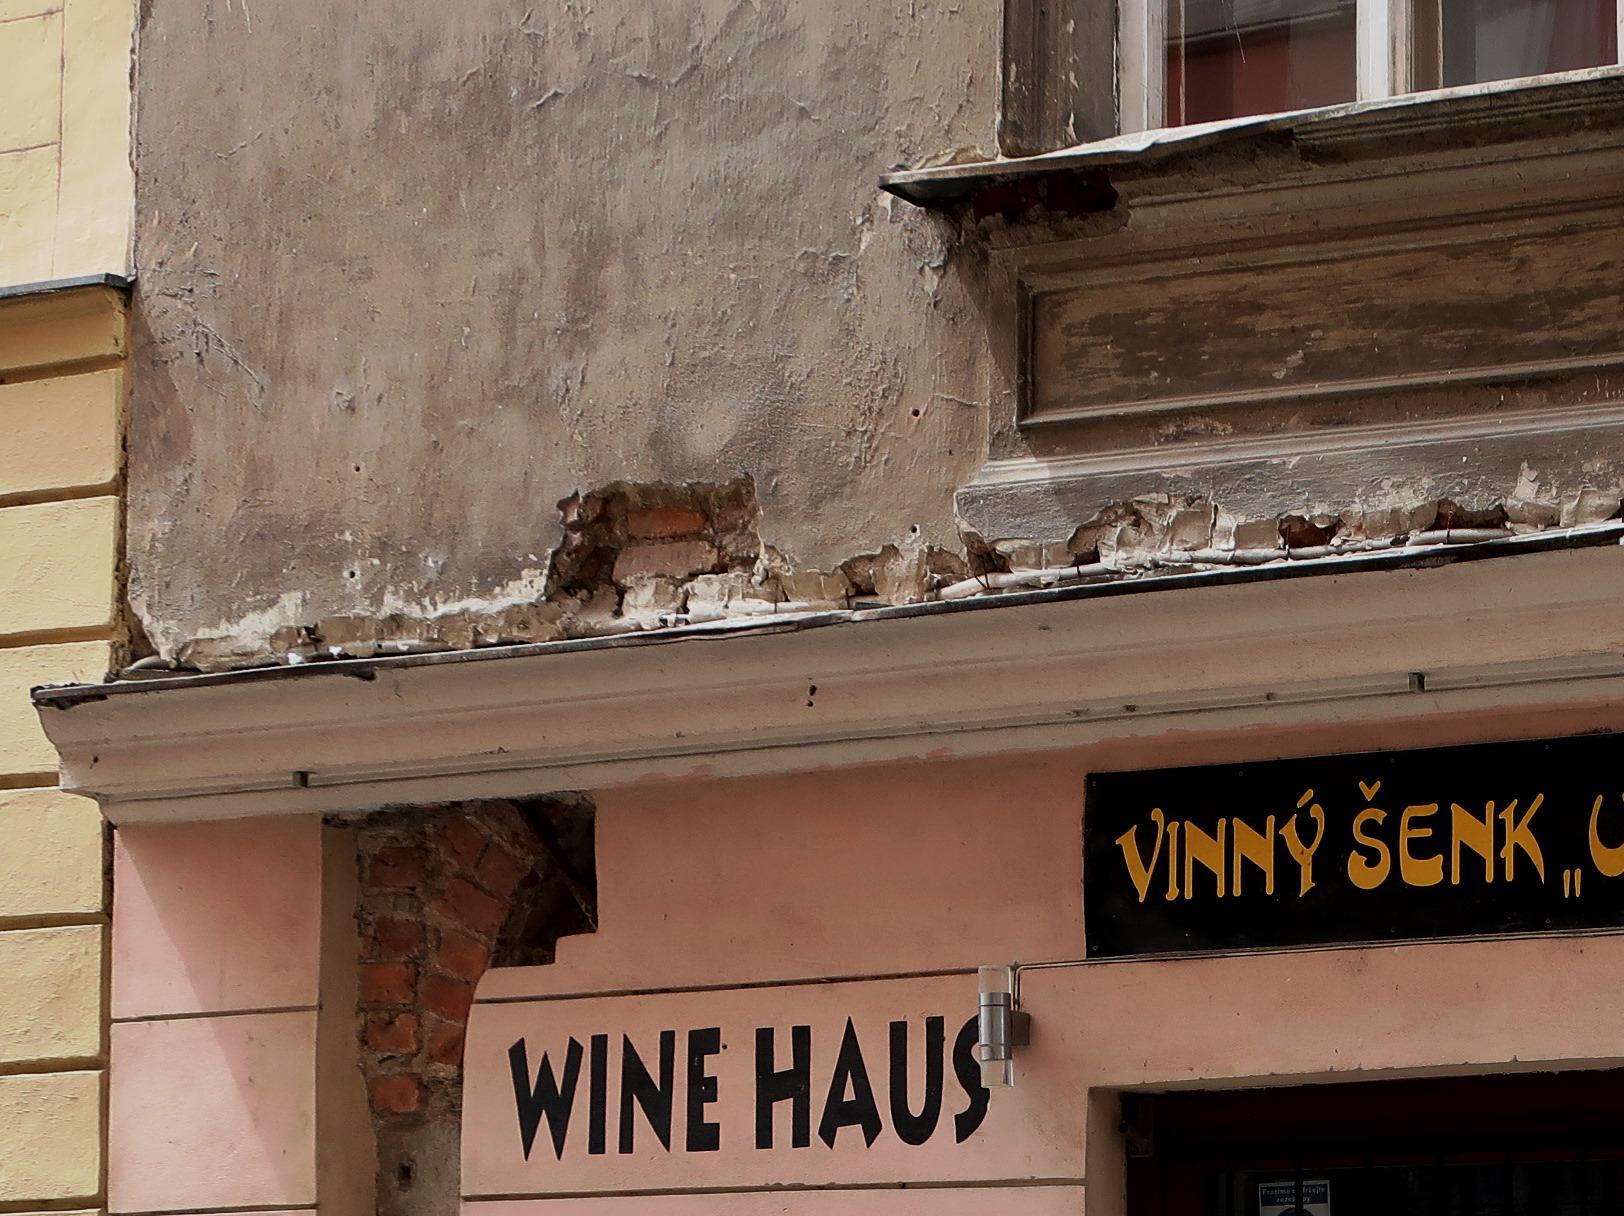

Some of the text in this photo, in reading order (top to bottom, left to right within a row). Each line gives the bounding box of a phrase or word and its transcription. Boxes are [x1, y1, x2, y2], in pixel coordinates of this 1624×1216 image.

[1115, 788, 1325, 902] VINNÝ
[1347, 780, 1545, 890] ŠENK
[508, 1014, 992, 1161] WINE HAUS
